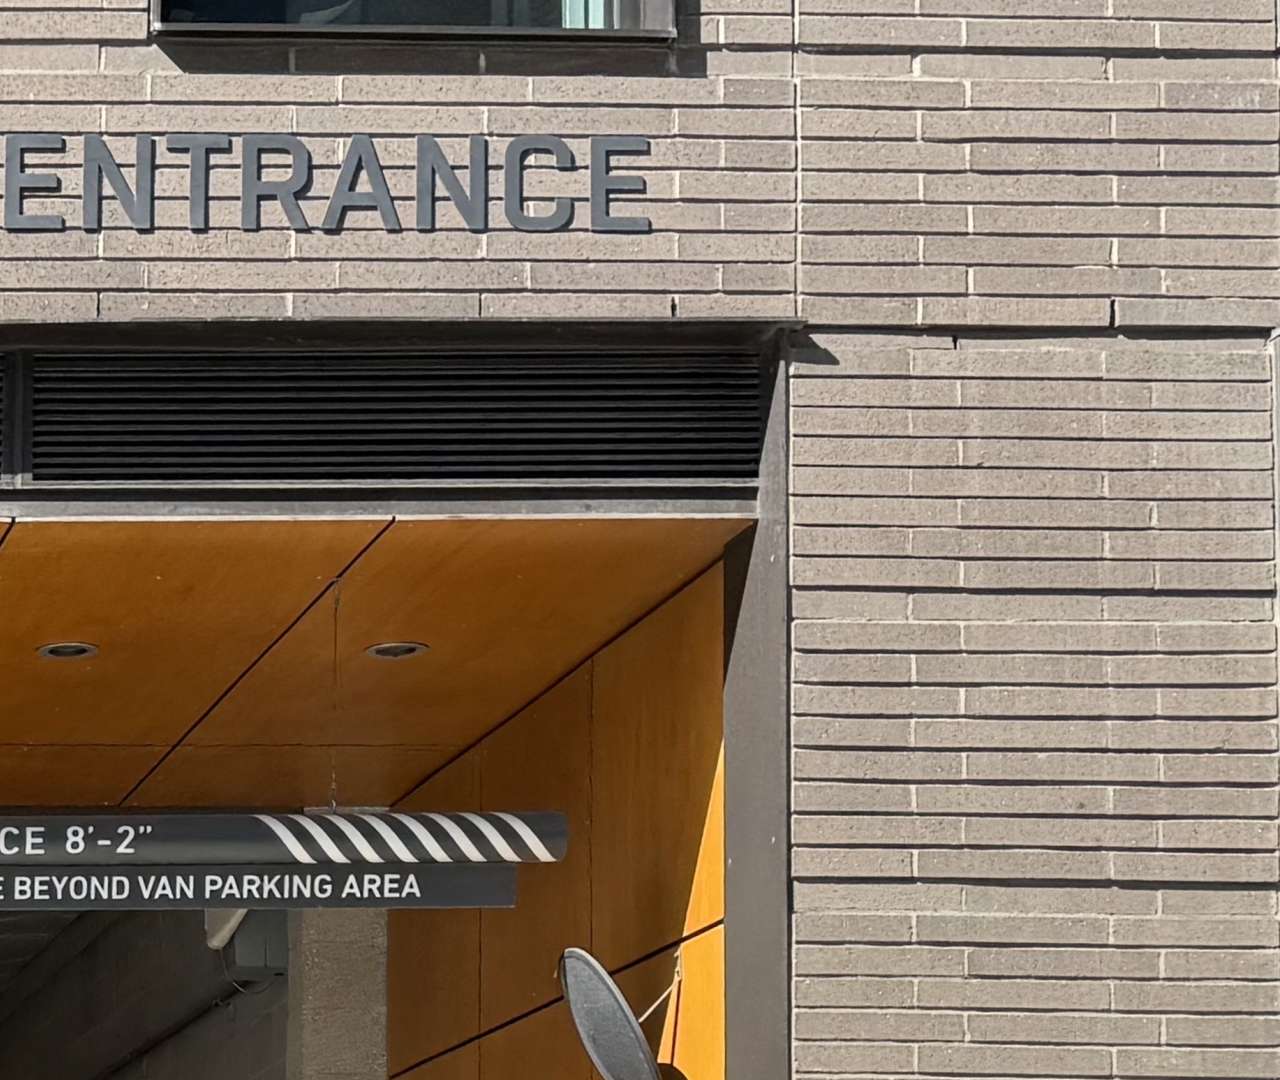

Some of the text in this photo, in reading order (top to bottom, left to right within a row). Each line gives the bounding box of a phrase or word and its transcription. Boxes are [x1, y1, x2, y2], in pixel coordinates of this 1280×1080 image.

[4, 133, 651, 233] ENTRANCE
[13, 875, 131, 900] BEYOND
[137, 874, 195, 900] VAN
[204, 873, 333, 899] PARKING
[340, 872, 422, 899] AREA
